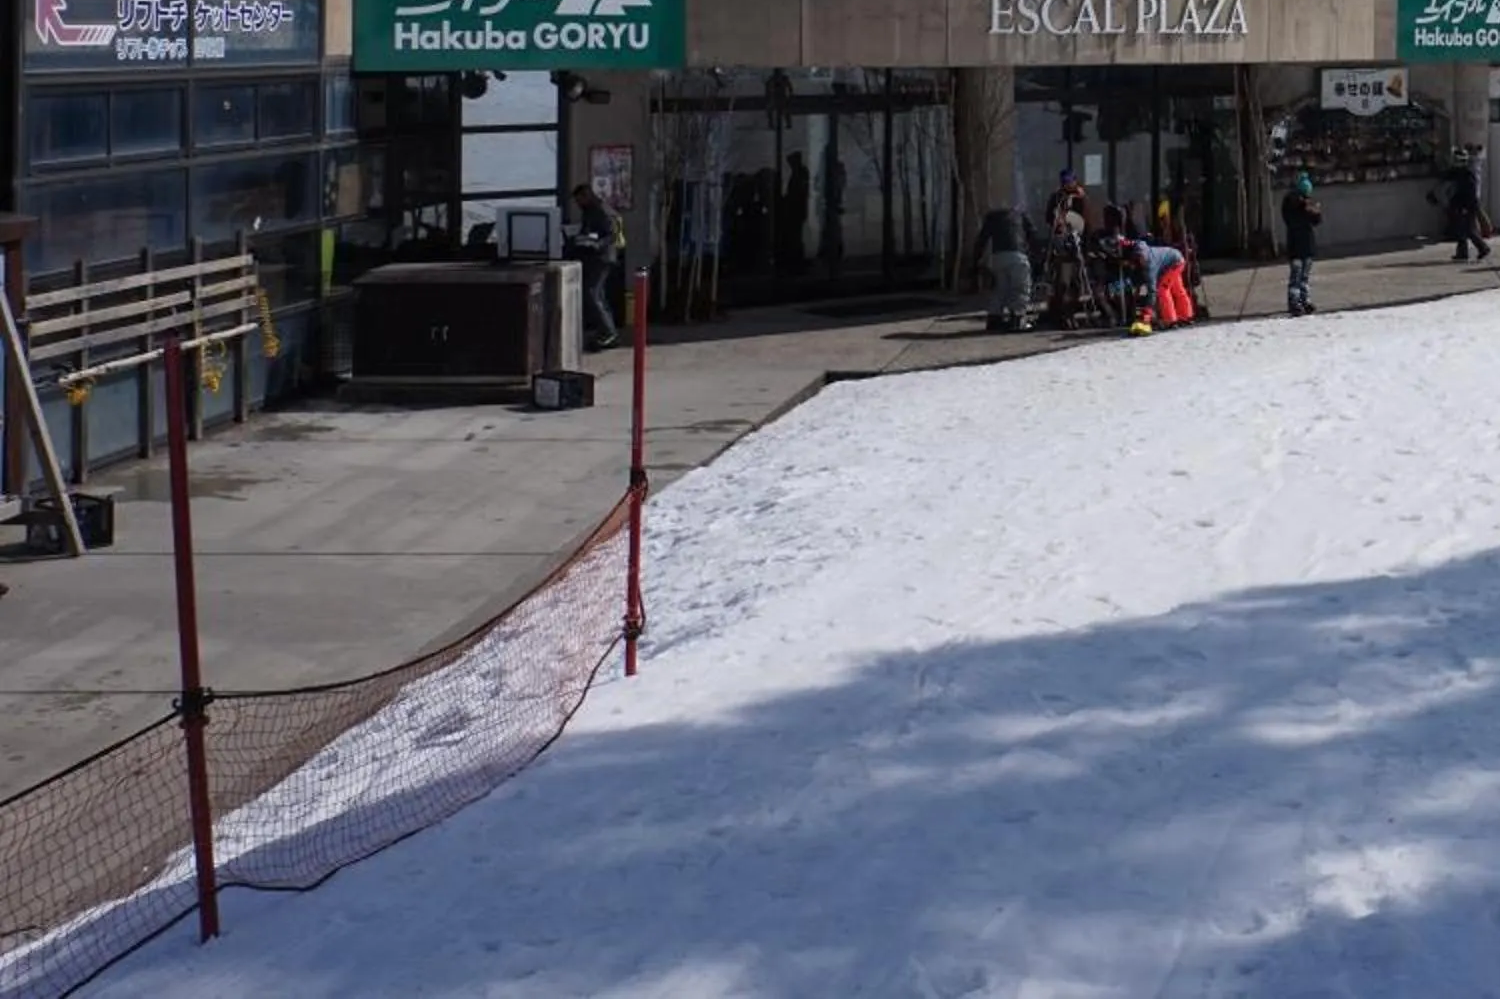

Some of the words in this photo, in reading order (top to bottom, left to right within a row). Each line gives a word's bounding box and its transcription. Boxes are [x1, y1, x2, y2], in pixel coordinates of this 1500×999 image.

[394, 20, 526, 50] Hakuba
[532, 22, 649, 49] GORYU
[1414, 26, 1473, 46] Hakuba
